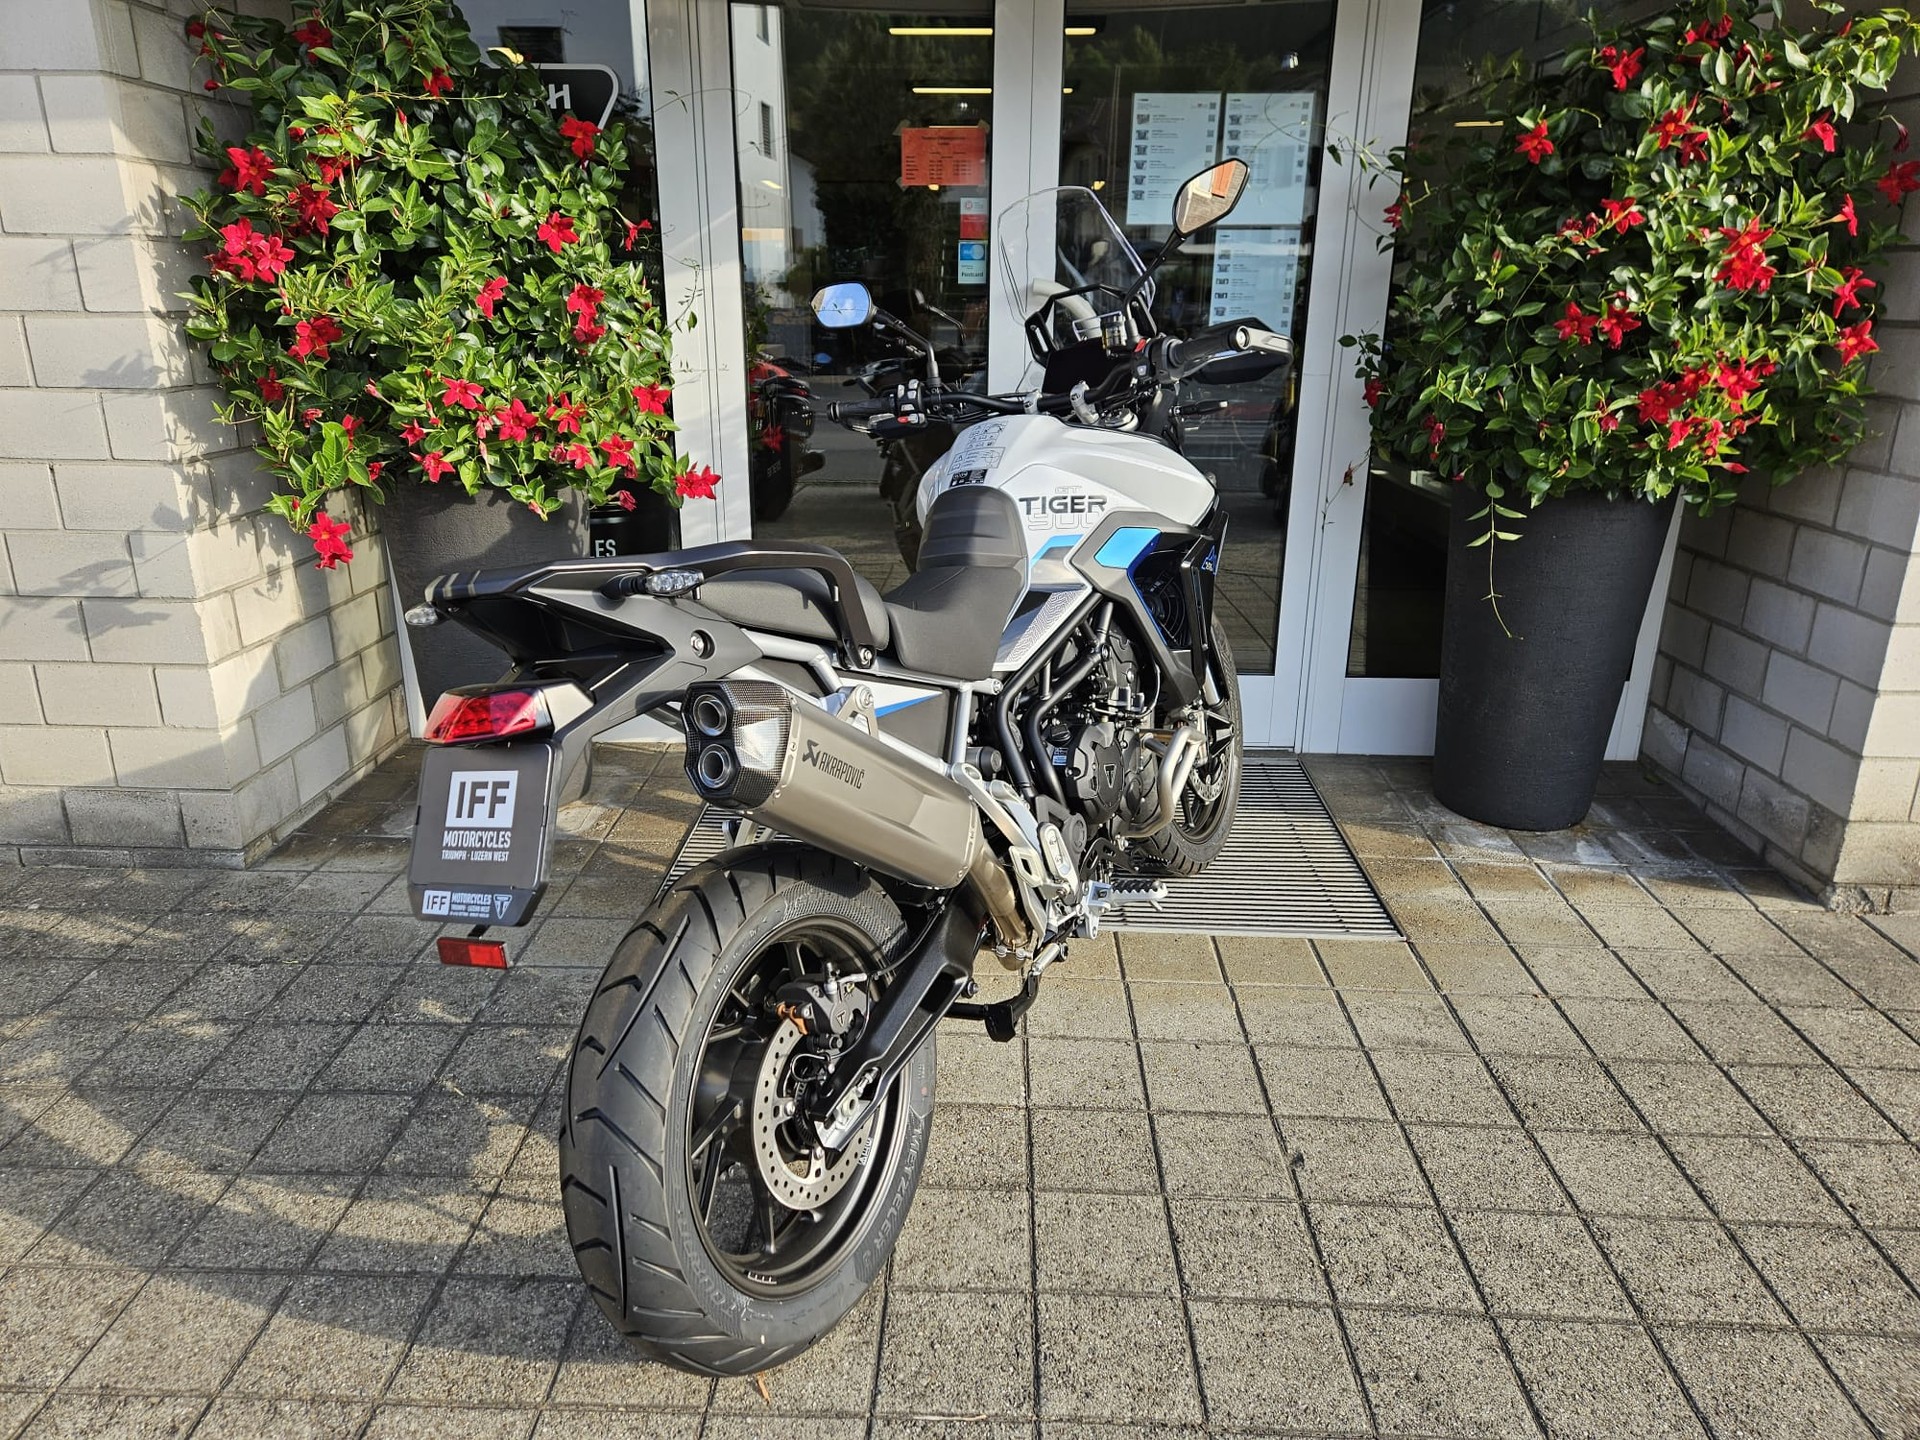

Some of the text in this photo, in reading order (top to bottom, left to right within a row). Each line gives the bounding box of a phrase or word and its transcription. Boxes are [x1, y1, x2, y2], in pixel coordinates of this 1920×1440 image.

[1018, 495, 1108, 515] TIGER
[455, 780, 510, 819] IFF
[442, 830, 512, 849] MOTORCYCLES
[441, 849, 510, 862] TRIUMPH LUZERN WEST
[426, 894, 448, 911] IFF
